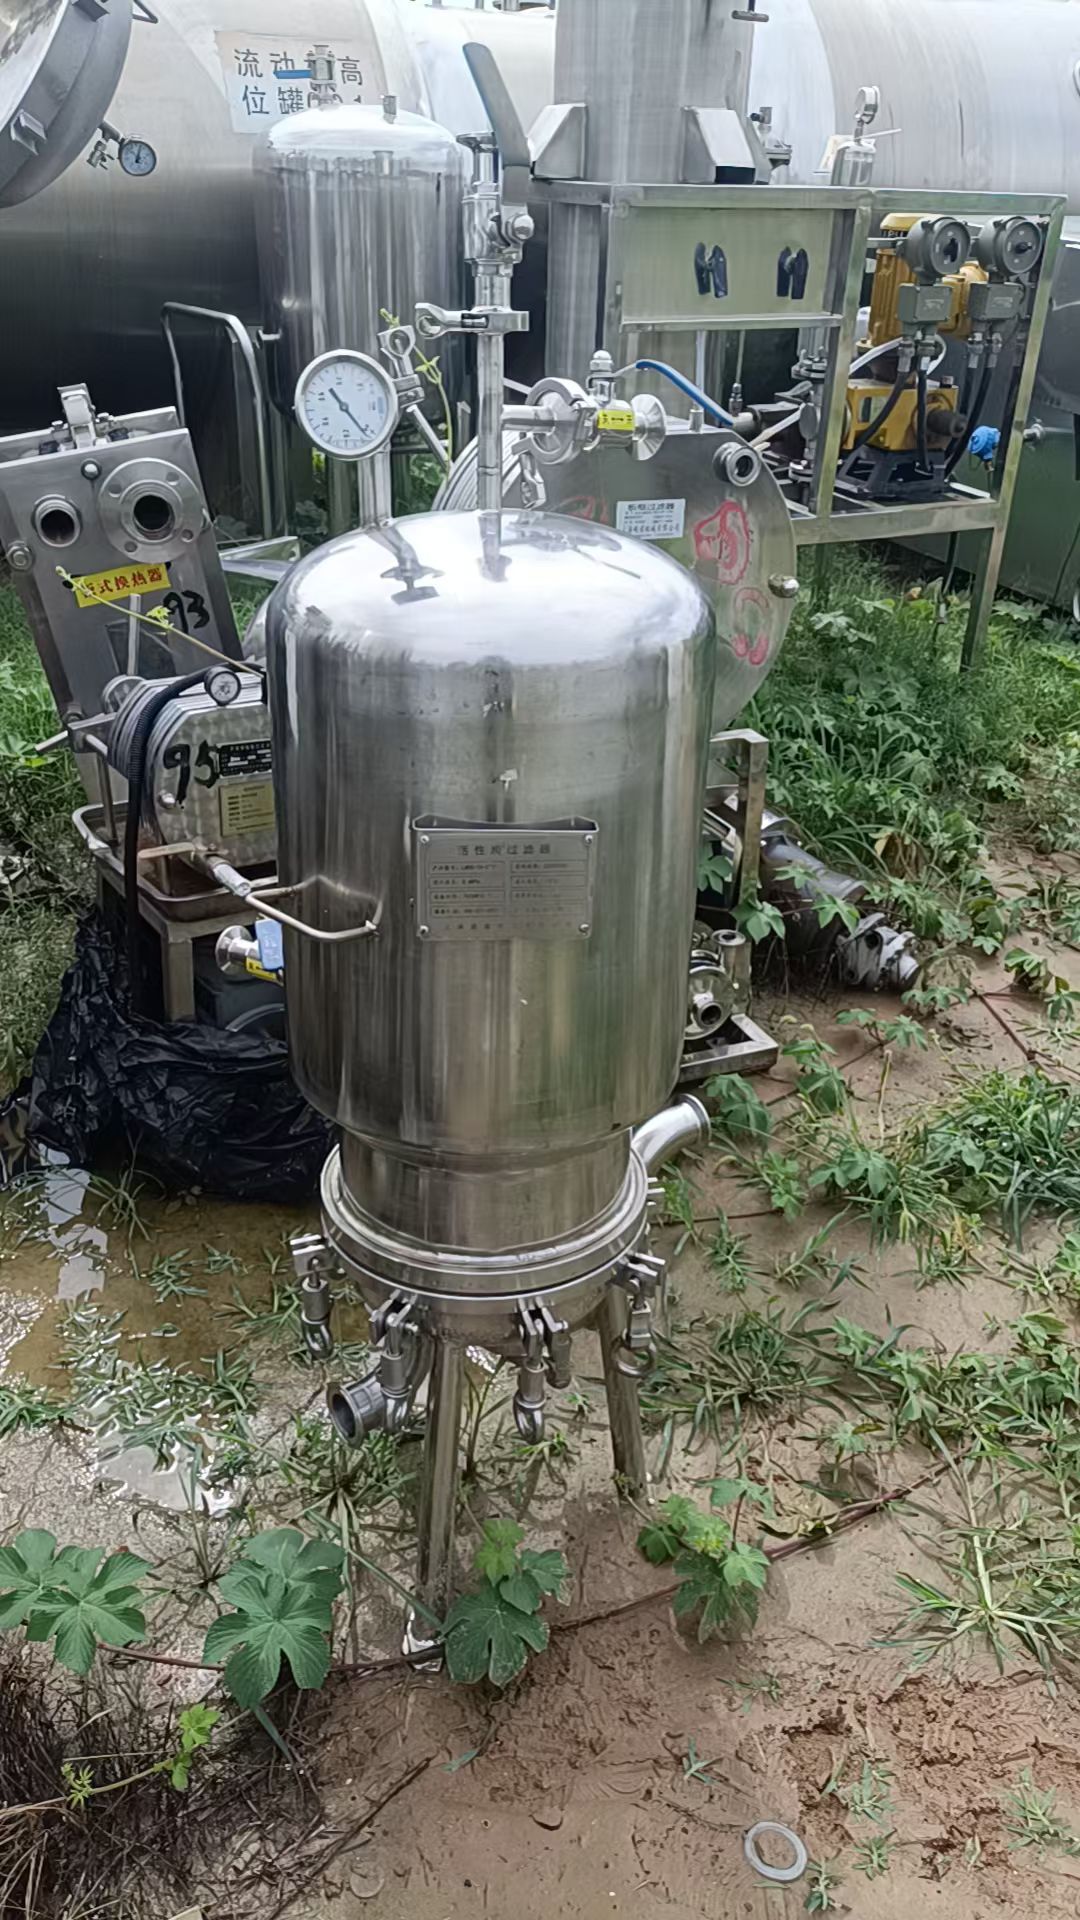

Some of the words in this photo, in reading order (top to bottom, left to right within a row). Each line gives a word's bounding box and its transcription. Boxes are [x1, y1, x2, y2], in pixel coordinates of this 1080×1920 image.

[234, 48, 363, 86] 流动高
[163, 590, 210, 634] 93
[163, 740, 220, 806] 95
